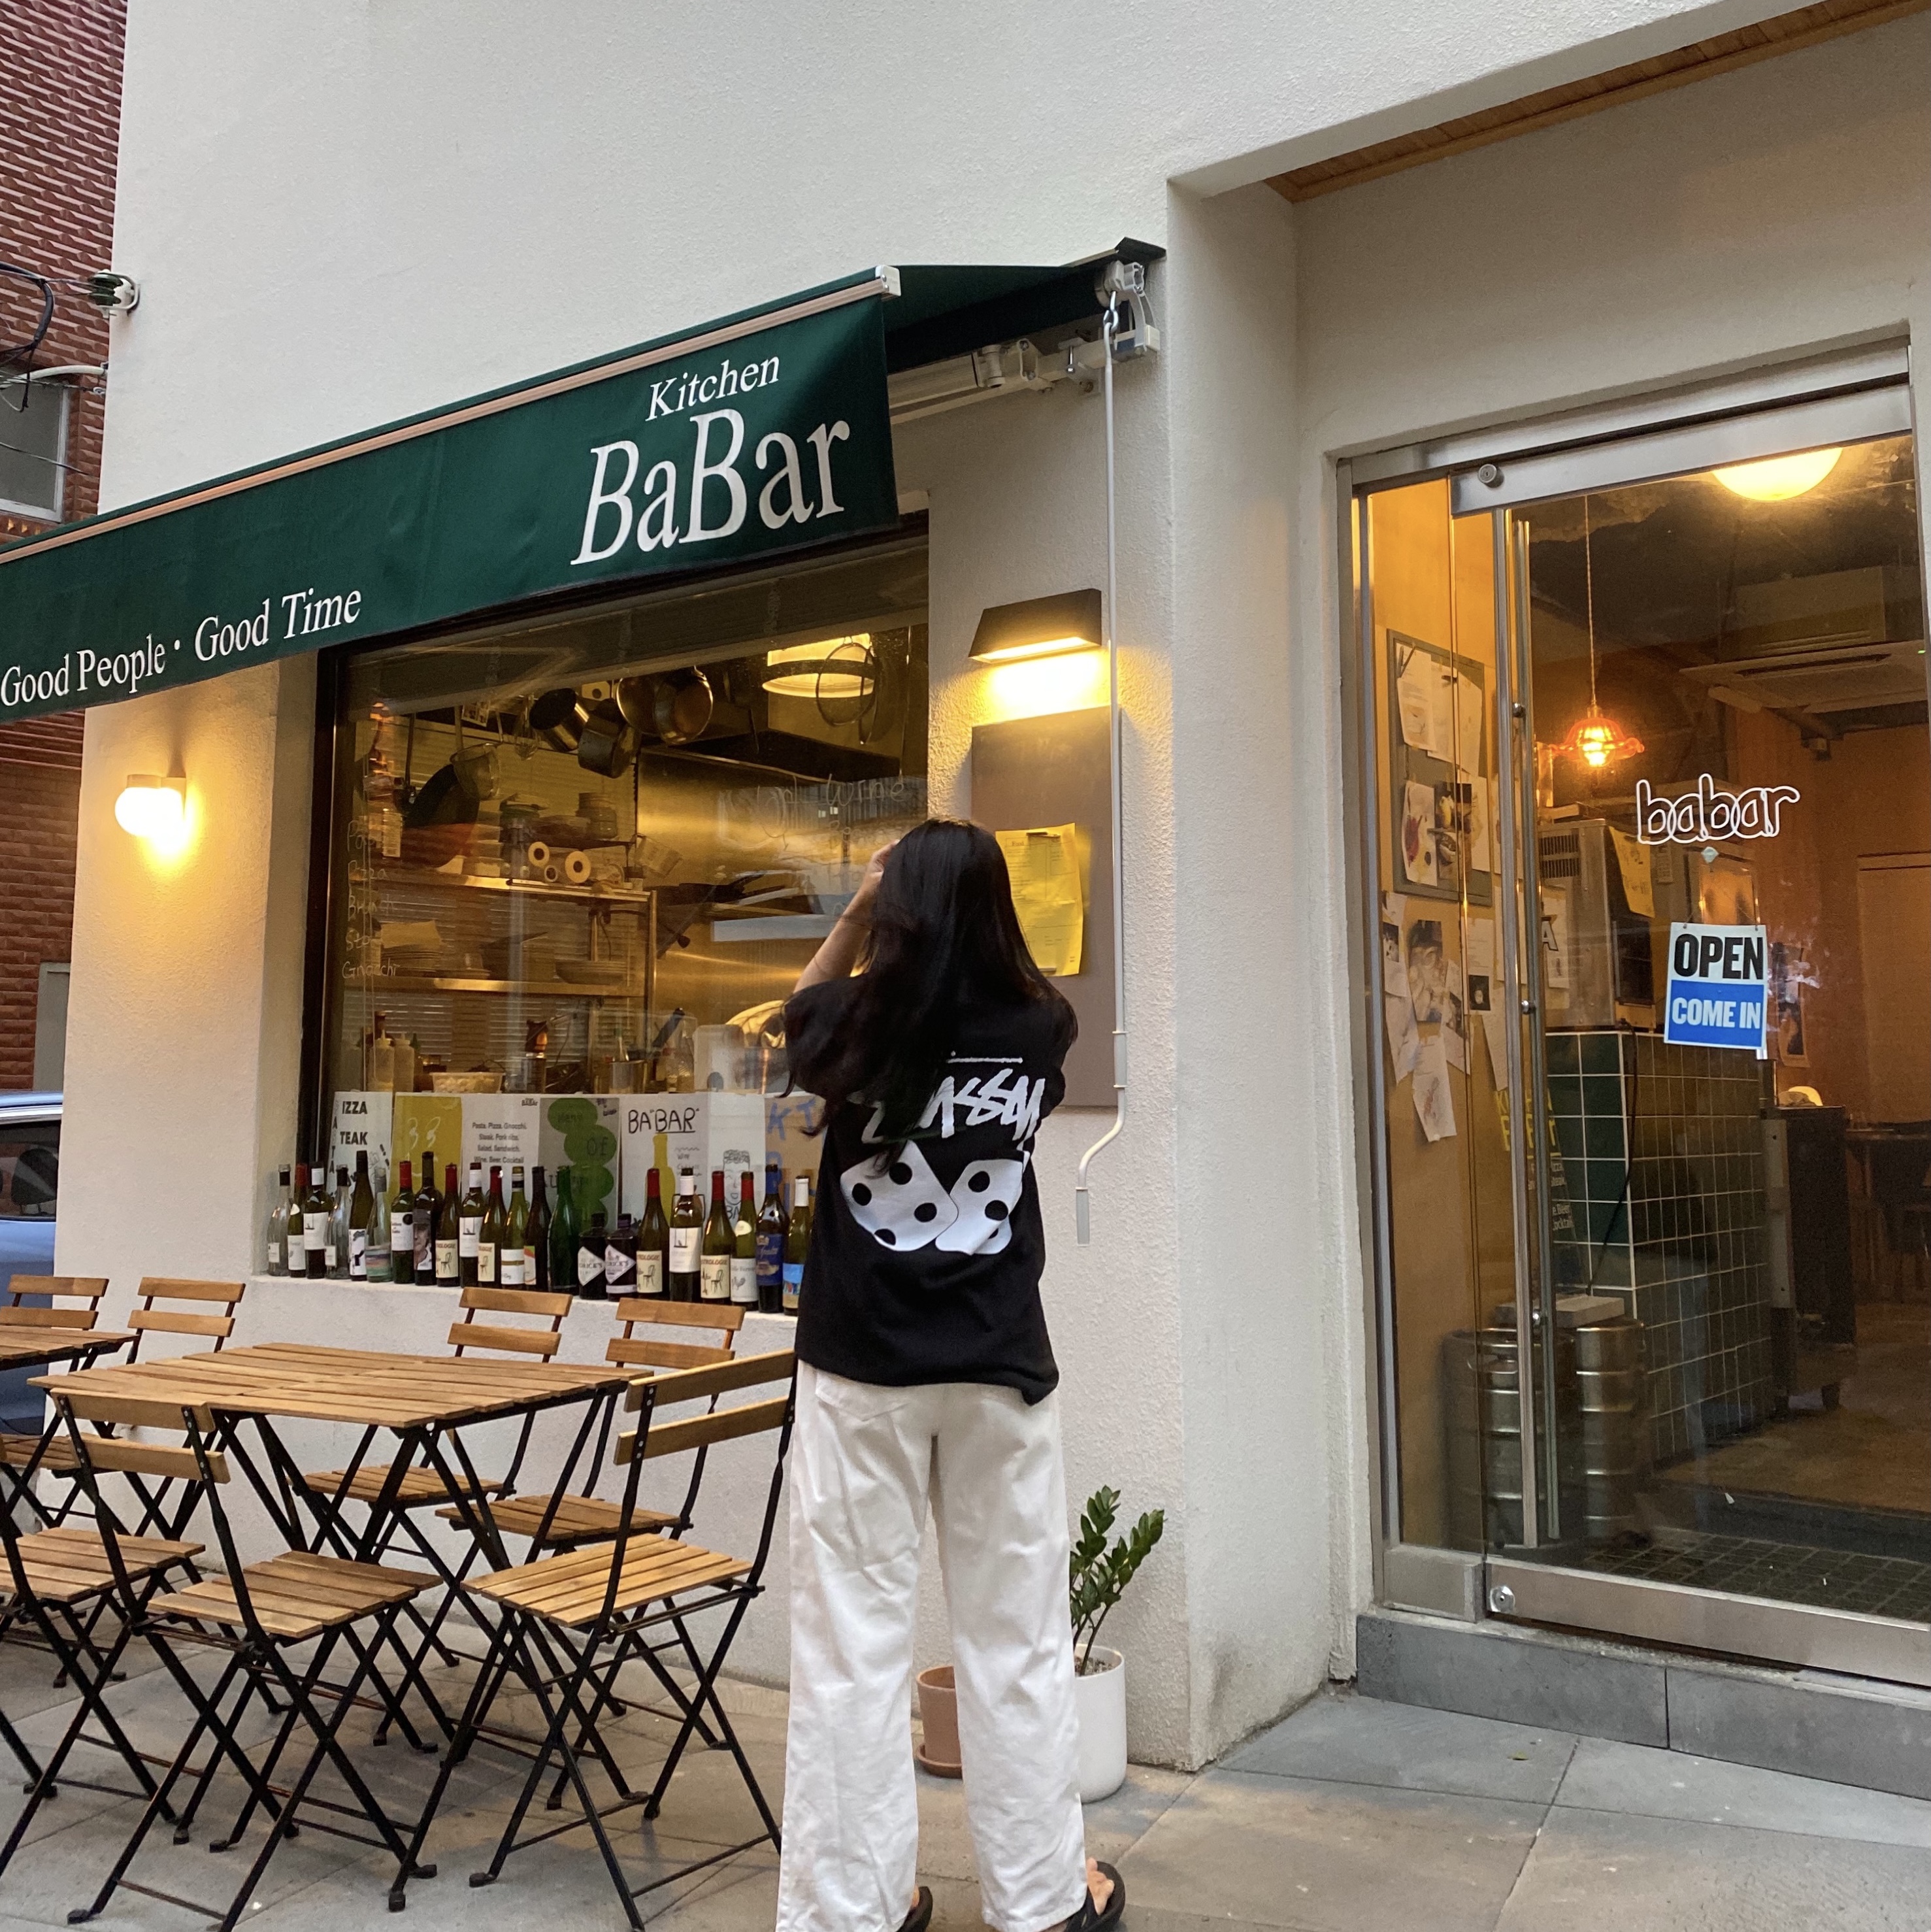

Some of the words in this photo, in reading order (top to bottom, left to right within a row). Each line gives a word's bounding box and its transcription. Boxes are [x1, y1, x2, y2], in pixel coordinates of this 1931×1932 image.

[645, 356, 780, 422] Kitchen
[570, 408, 850, 565] BaBar
[1, 665, 69, 707] Good
[76, 633, 166, 694] People
[195, 598, 270, 662] Good
[282, 588, 362, 640] Time
[1636, 773, 1800, 846] babar
[1674, 933, 1763, 980] OPEN
[1672, 997, 1735, 1029] COME
[1739, 1002, 1760, 1029] IN
